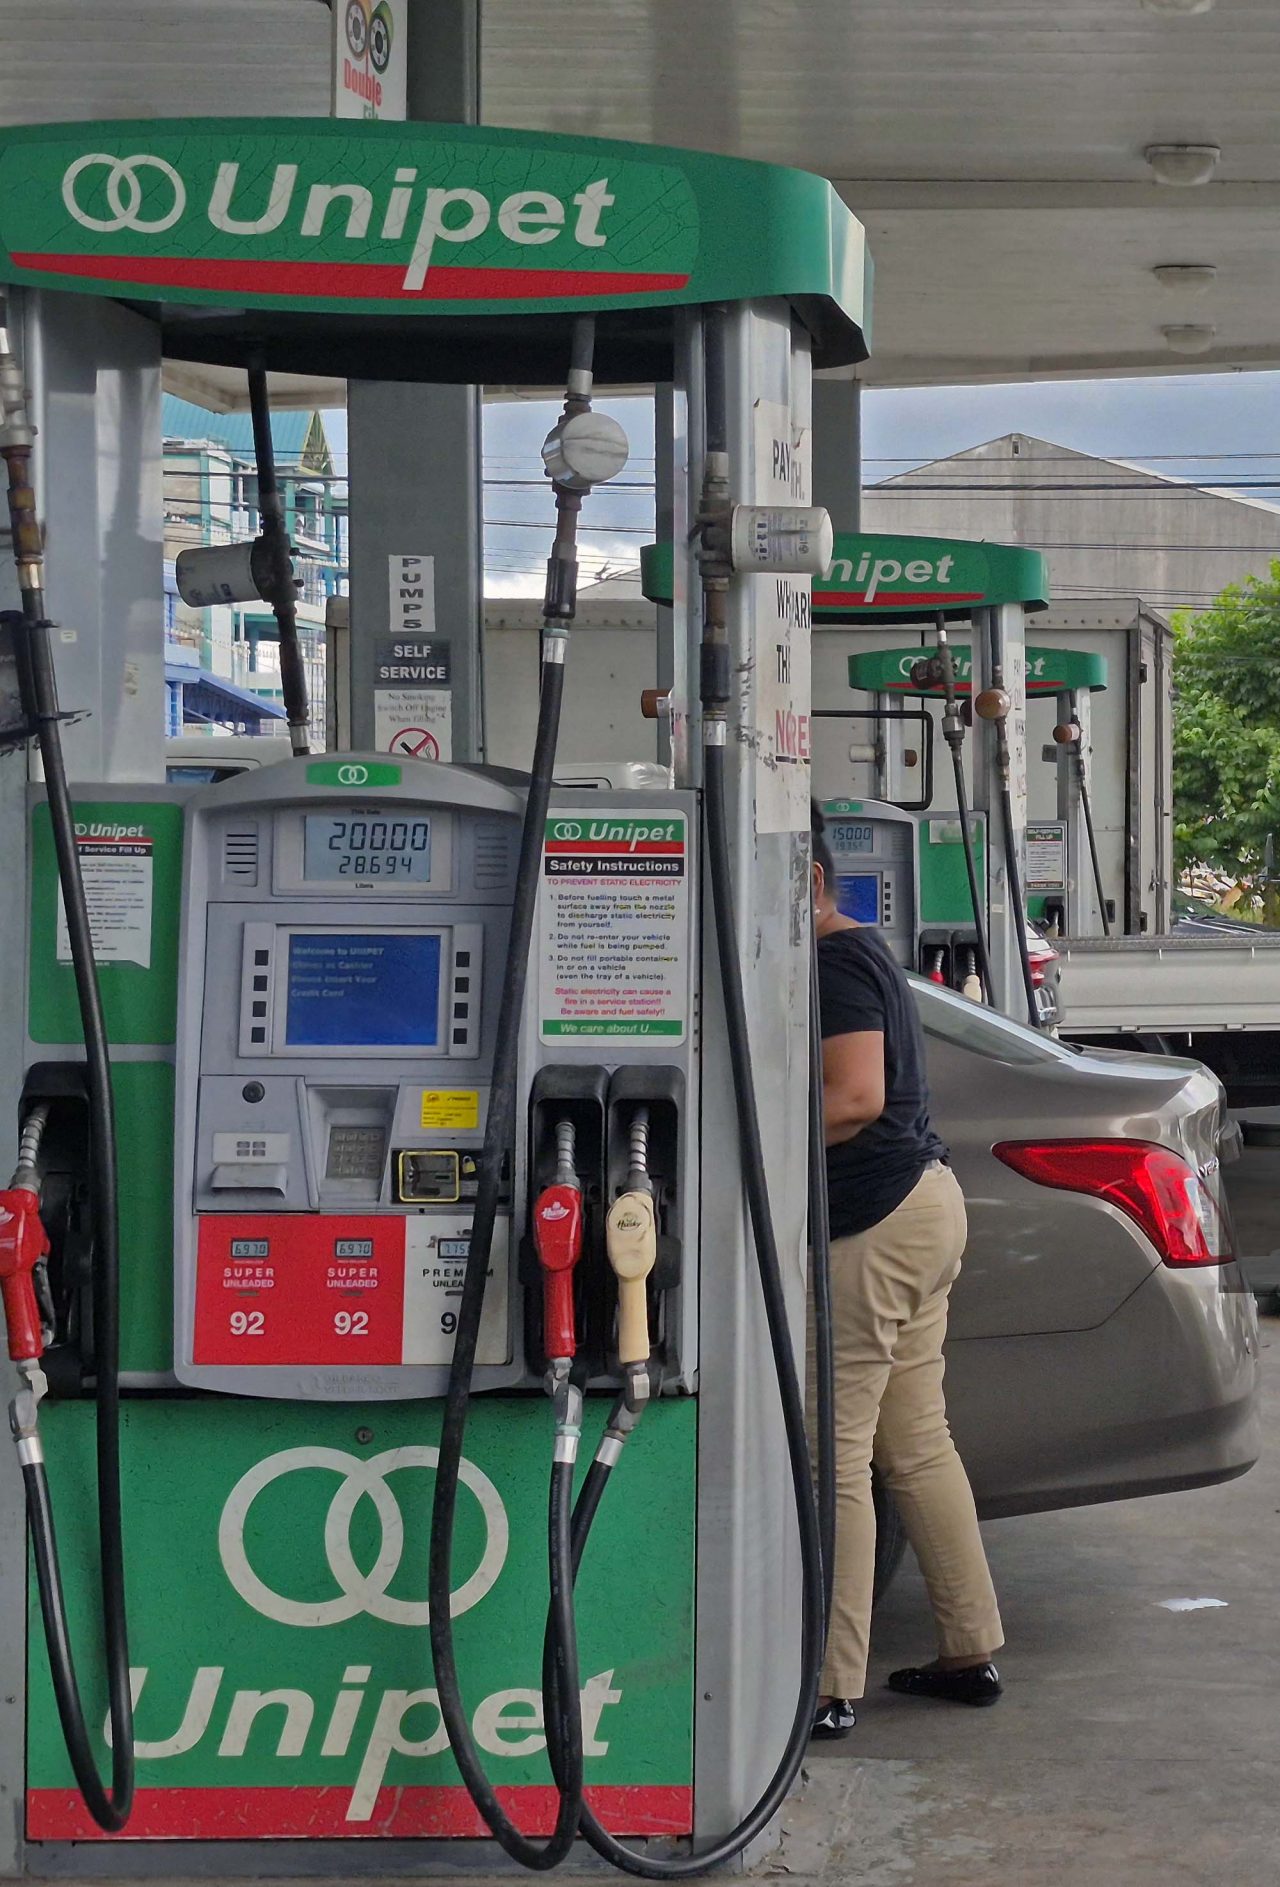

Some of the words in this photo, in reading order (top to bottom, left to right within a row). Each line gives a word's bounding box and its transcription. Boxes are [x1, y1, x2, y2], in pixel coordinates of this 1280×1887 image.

[343, 48, 383, 107] Double
[207, 163, 616, 291] Unipet
[821, 551, 955, 603] nipet
[393, 645, 432, 658] SELF
[379, 666, 447, 680] SERVICE
[89, 823, 145, 841] Unipet
[589, 822, 675, 852] Unipet
[338, 855, 412, 874] 28.694
[550, 859, 594, 873] Safety
[597, 859, 679, 872] Instructions
[547, 878, 559, 886] TO
[560, 878, 598, 886] PREVENT
[600, 878, 627, 886] STATIC
[629, 878, 682, 886] ELECTRICITY
[560, 1023, 578, 1033] We
[580, 1025, 604, 1033] care
[606, 1023, 637, 1033] about
[223, 1267, 275, 1278] SUPER
[327, 1267, 378, 1278] SUPER
[222, 1279, 275, 1288] UNLEADED
[326, 1279, 378, 1288] UNLEADED
[432, 1279, 465, 1288] UNLEA
[229, 1311, 265, 1335] 92
[333, 1311, 369, 1335] 92
[440, 1311, 458, 1335] 9
[104, 1665, 622, 1822] Unipet
